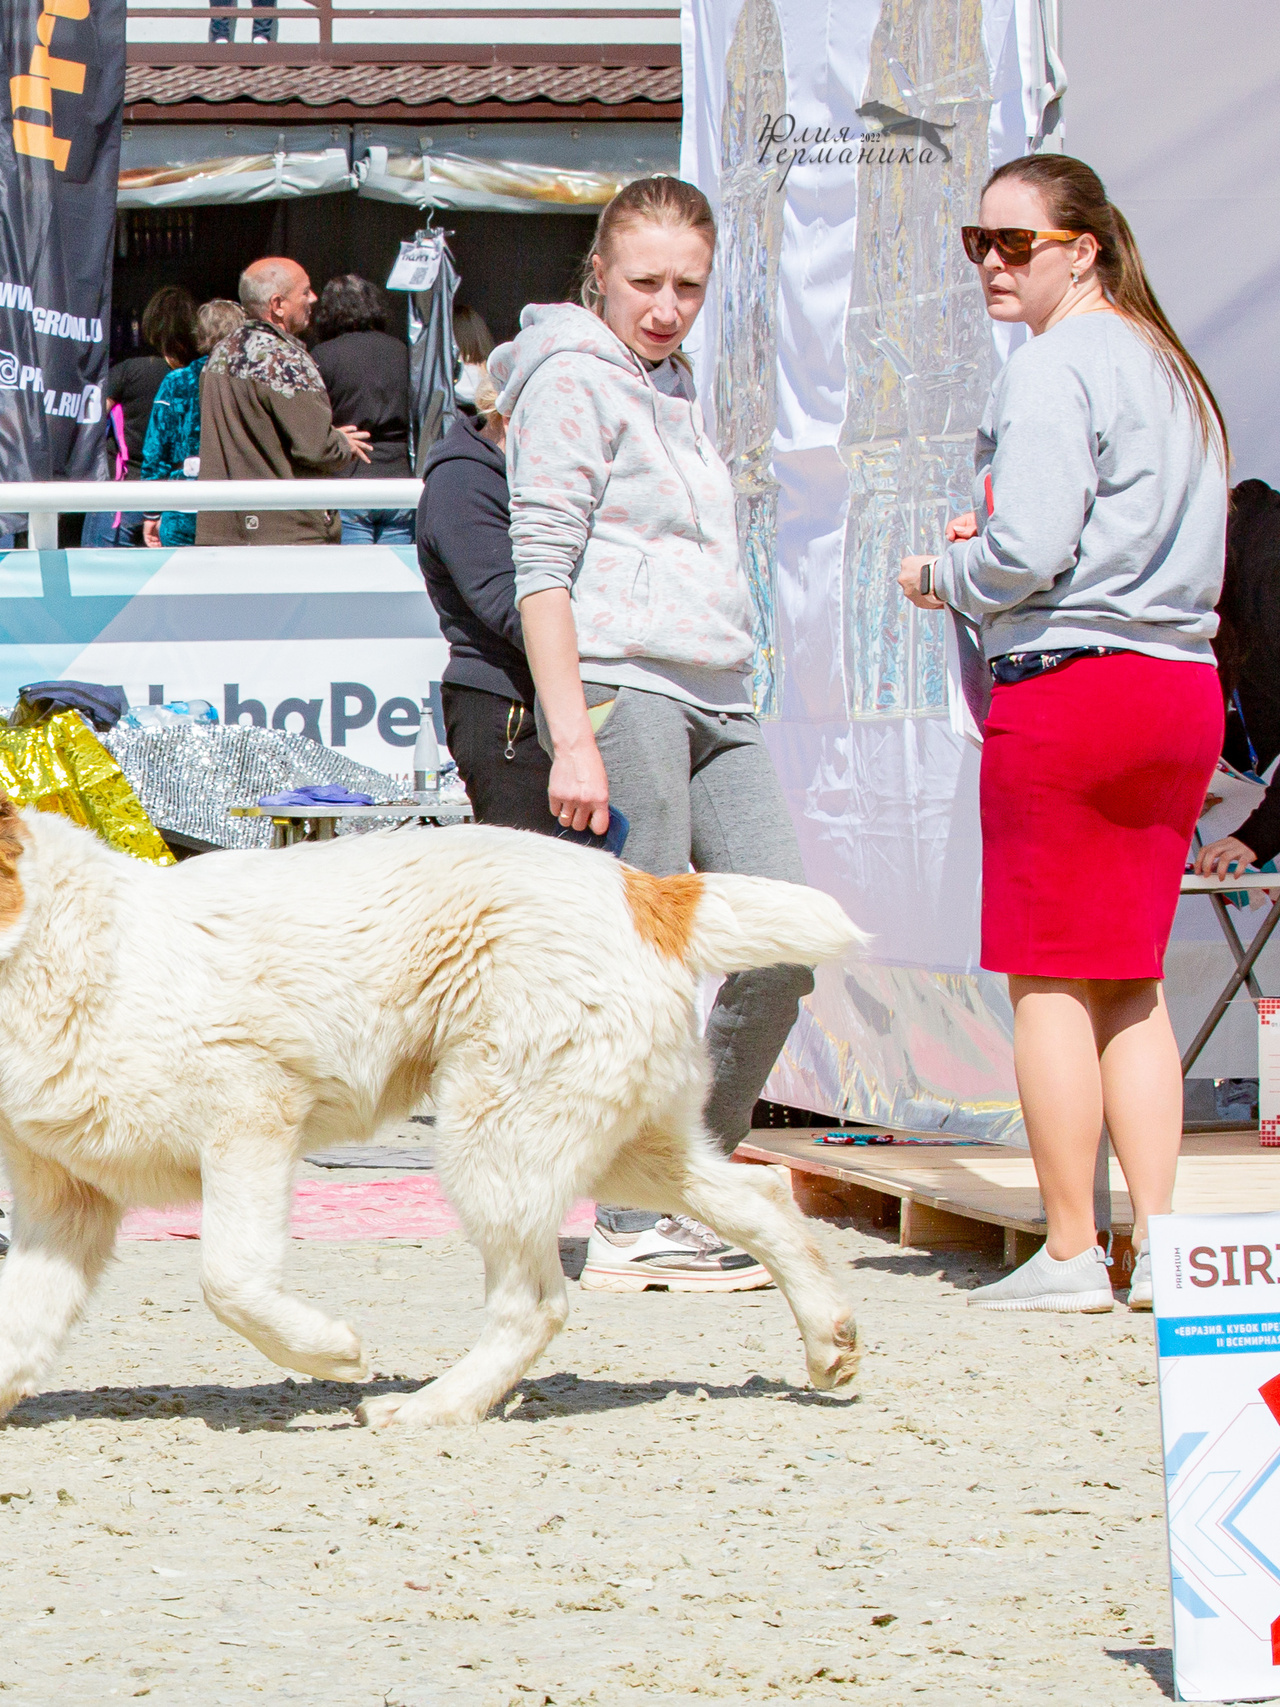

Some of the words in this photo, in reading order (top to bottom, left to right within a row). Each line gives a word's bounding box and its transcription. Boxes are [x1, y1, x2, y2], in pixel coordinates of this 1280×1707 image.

[1174, 1247, 1183, 1289] PREMIUM
[1189, 1243, 1280, 1288] SIR
[1226, 1323, 1259, 1335] КУБОК
[1261, 1322, 1280, 1332] ПРЕ
